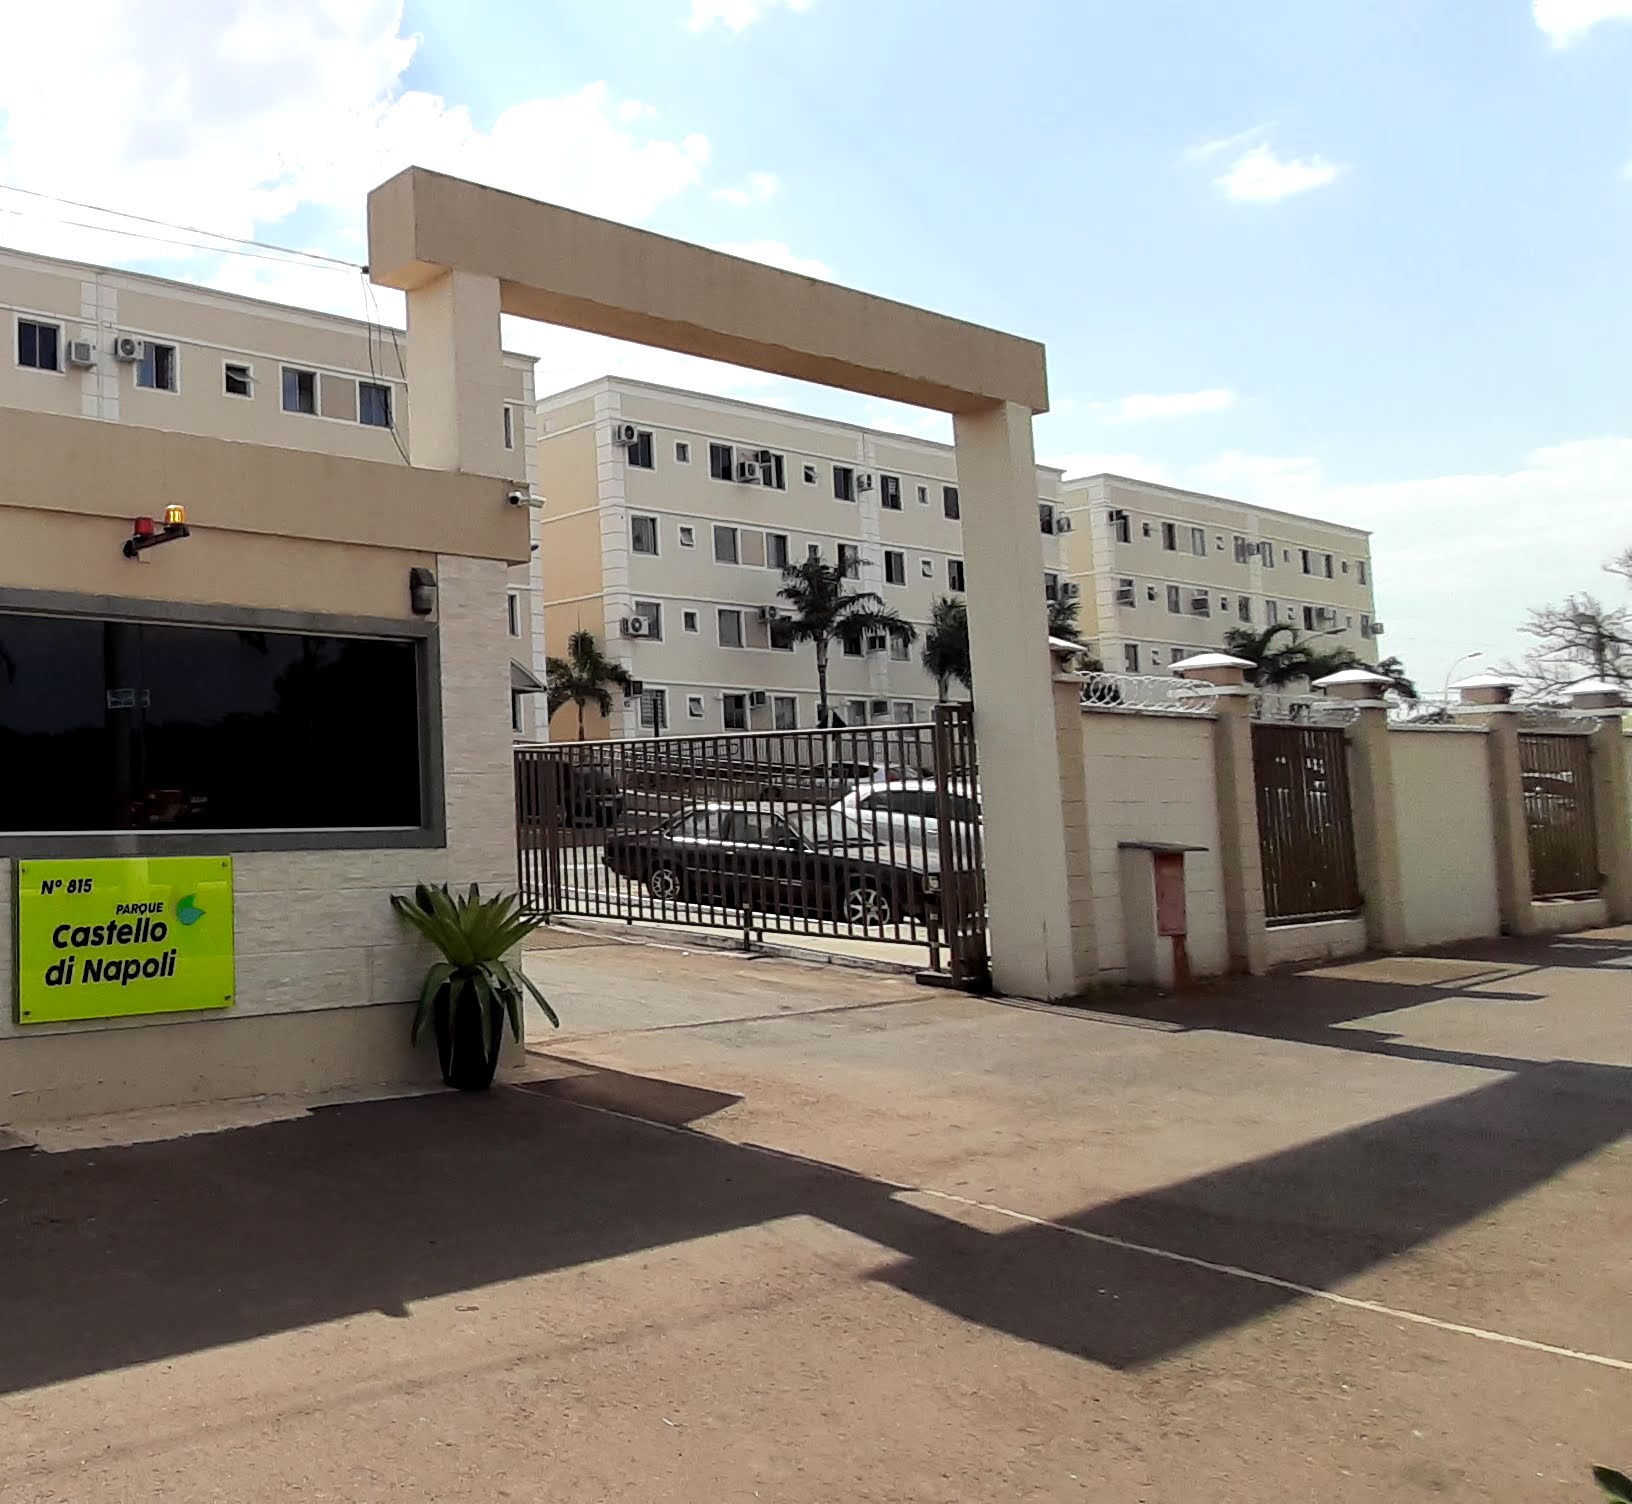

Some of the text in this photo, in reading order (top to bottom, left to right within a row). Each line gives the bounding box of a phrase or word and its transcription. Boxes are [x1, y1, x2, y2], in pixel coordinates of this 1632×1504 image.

[67, 878, 92, 894] 815
[115, 902, 164, 916] PARQUE
[52, 917, 168, 949] Castello
[44, 949, 177, 987] di Napoli
